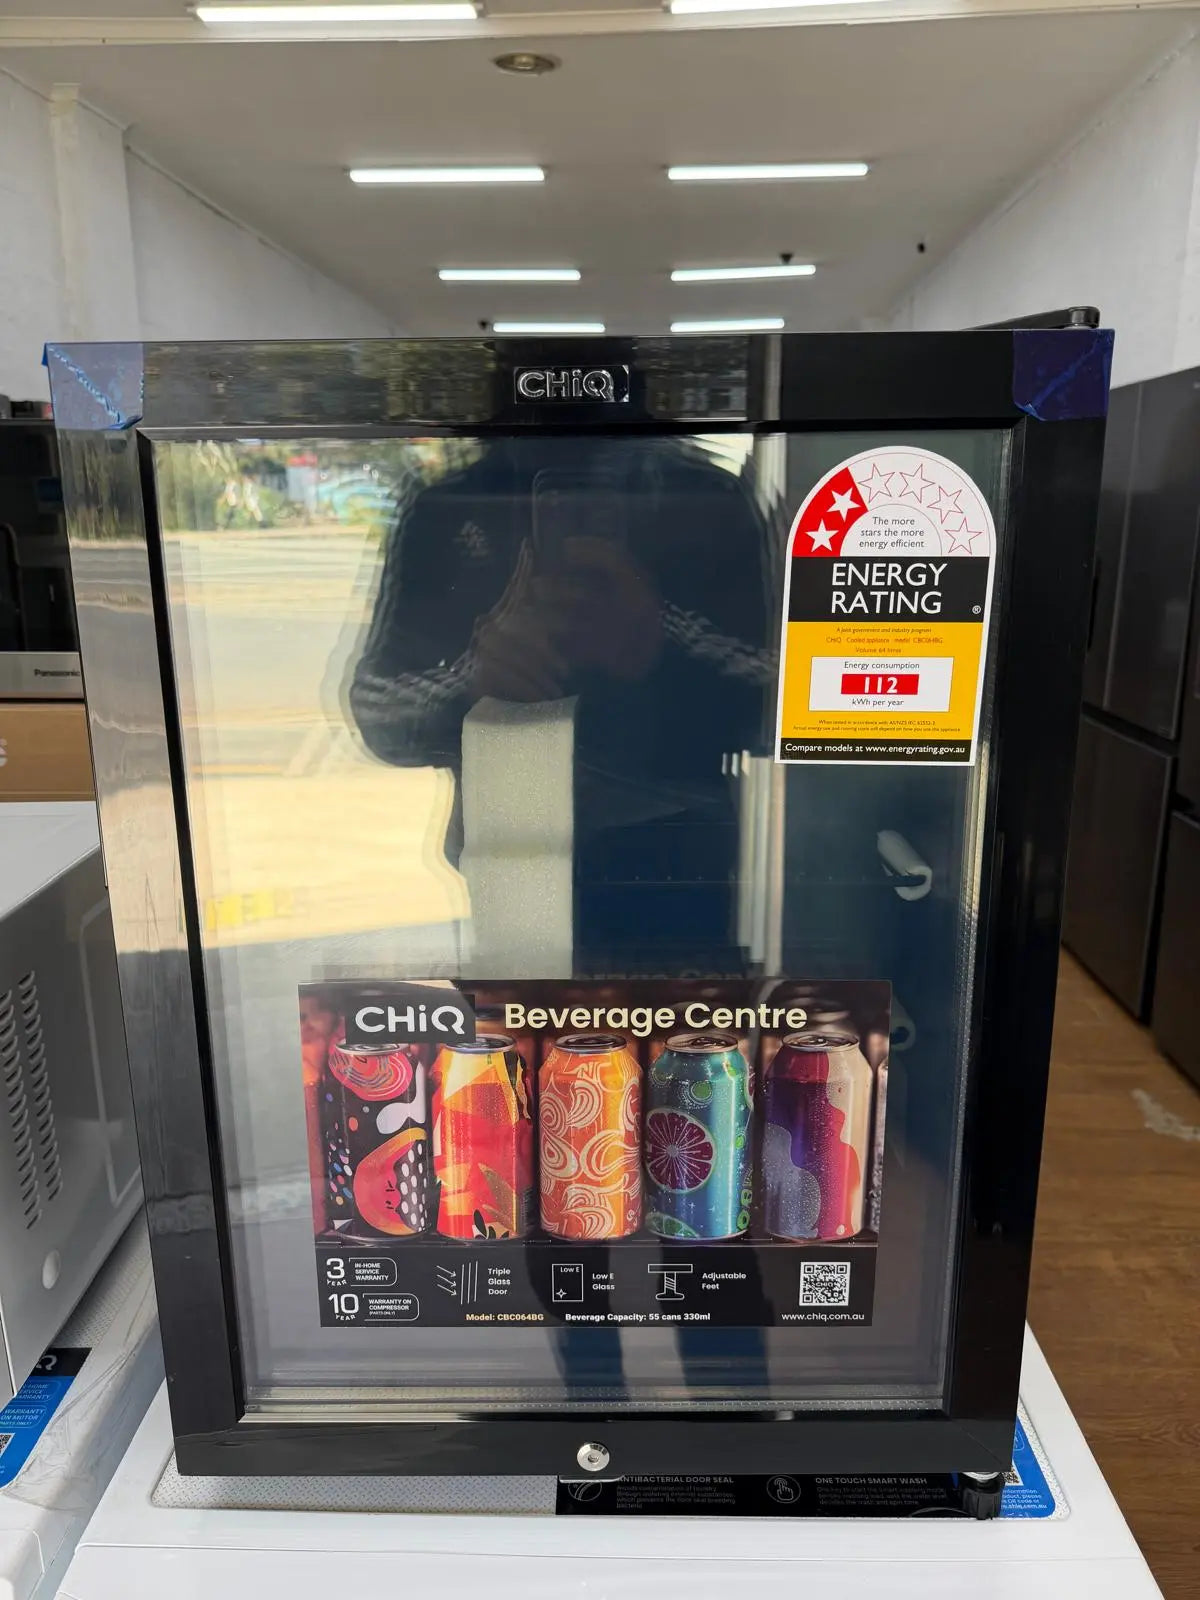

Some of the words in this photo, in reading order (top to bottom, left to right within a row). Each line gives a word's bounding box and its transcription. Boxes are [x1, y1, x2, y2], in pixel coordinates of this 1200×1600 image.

[516, 369, 615, 402] CHiQ
[873, 516, 889, 525] The
[861, 529, 882, 537] stars
[884, 528, 899, 537] the
[900, 529, 925, 537] more
[859, 541, 887, 550] energy
[890, 539, 925, 548] efficient
[831, 562, 948, 587] ENERGY
[831, 591, 942, 614] RATING
[844, 661, 870, 671] Energy
[871, 662, 920, 670] consumption
[864, 676, 898, 694] 112
[852, 698, 871, 706] kWh
[785, 743, 823, 753] Compare
[825, 744, 853, 752] models
[865, 745, 965, 755] www.energyrating.gov.au
[354, 1005, 466, 1035] CHiQ
[504, 1002, 676, 1036] Beverage
[684, 1002, 808, 1030] Centre
[326, 1257, 345, 1279] 3
[488, 1267, 511, 1276] Triple
[702, 1272, 746, 1281] Adjustable
[488, 1278, 511, 1286] Glass
[328, 1293, 359, 1314] 10
[466, 1313, 495, 1321] Model:
[497, 1313, 544, 1321] CBC064BG
[565, 1313, 605, 1322] Beverage
[607, 1313, 647, 1323] Capacity:
[683, 1313, 711, 1321] 330ml
[782, 1312, 865, 1322] www.chiq.com.au
